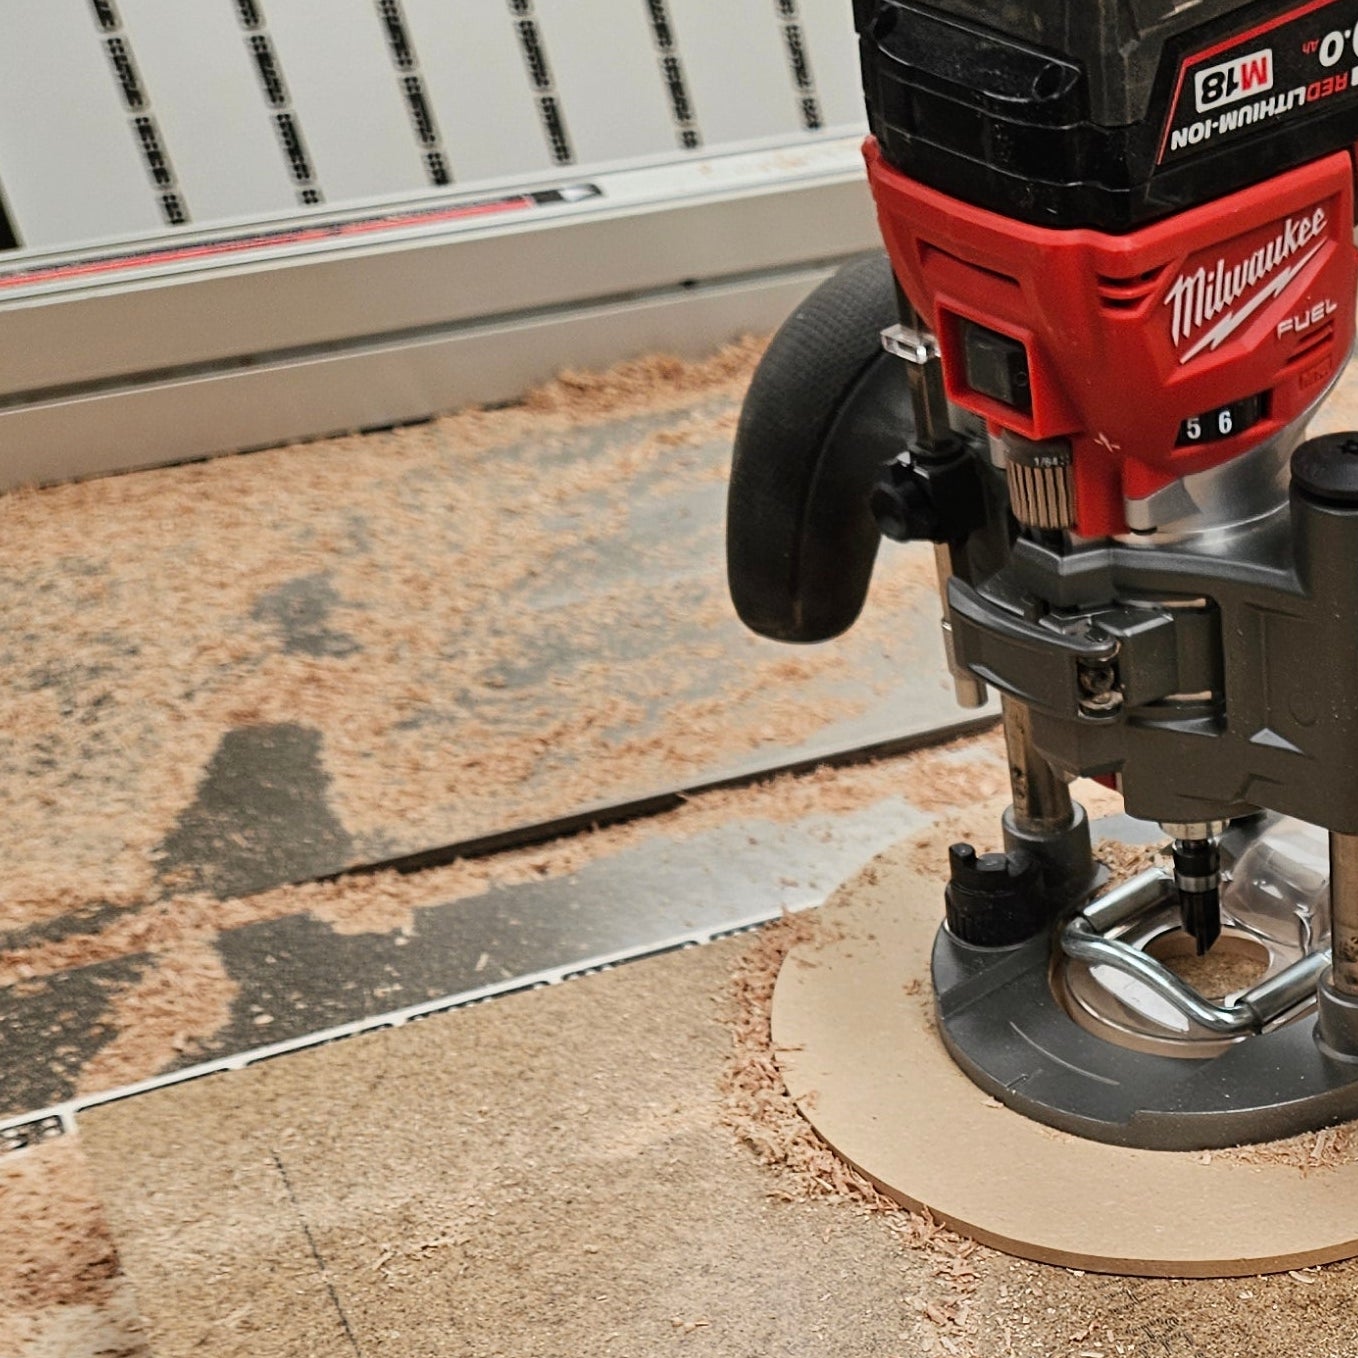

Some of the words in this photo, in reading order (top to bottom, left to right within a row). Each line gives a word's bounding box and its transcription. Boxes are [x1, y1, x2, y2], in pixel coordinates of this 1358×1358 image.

[1201, 56, 1268, 104] M18
[1163, 207, 1328, 347] Milwaukee
[1277, 299, 1338, 340] FUEL
[1186, 417, 1202, 440] 5
[1218, 410, 1233, 434] 6
